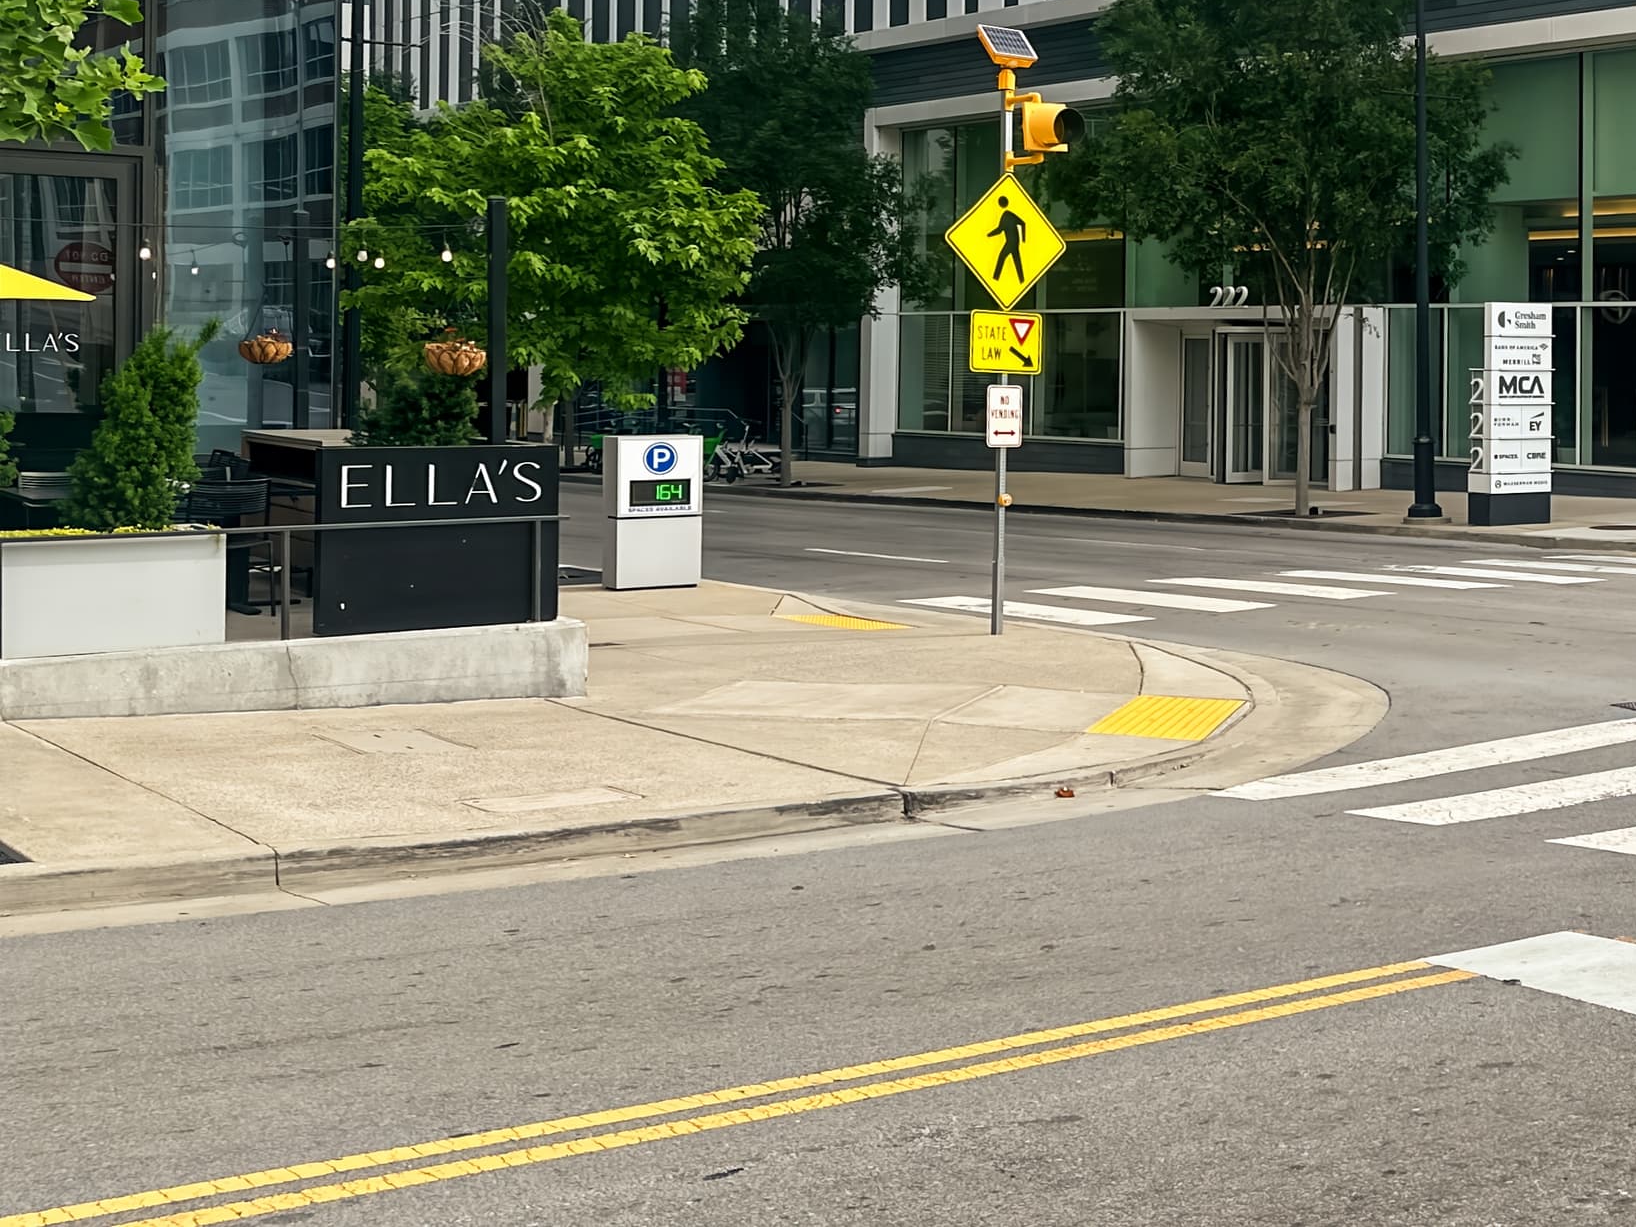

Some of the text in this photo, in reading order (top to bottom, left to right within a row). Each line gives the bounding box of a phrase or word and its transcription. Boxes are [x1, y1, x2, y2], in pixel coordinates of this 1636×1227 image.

[1209, 285, 1249, 309] 222
[1514, 310, 1547, 320] Gresham
[977, 324, 1008, 342] STATE
[1514, 321, 1537, 329] Smith
[0, 332, 80, 353] LLA'S
[981, 347, 1002, 361] LAW
[1498, 375, 1545, 394] MCA
[1000, 395, 1010, 405] NO
[991, 409, 1019, 419] VENDING
[1529, 421, 1542, 431] EY
[652, 447, 671, 469] P
[340, 458, 543, 509] ELLA'S
[656, 484, 683, 501] 164
